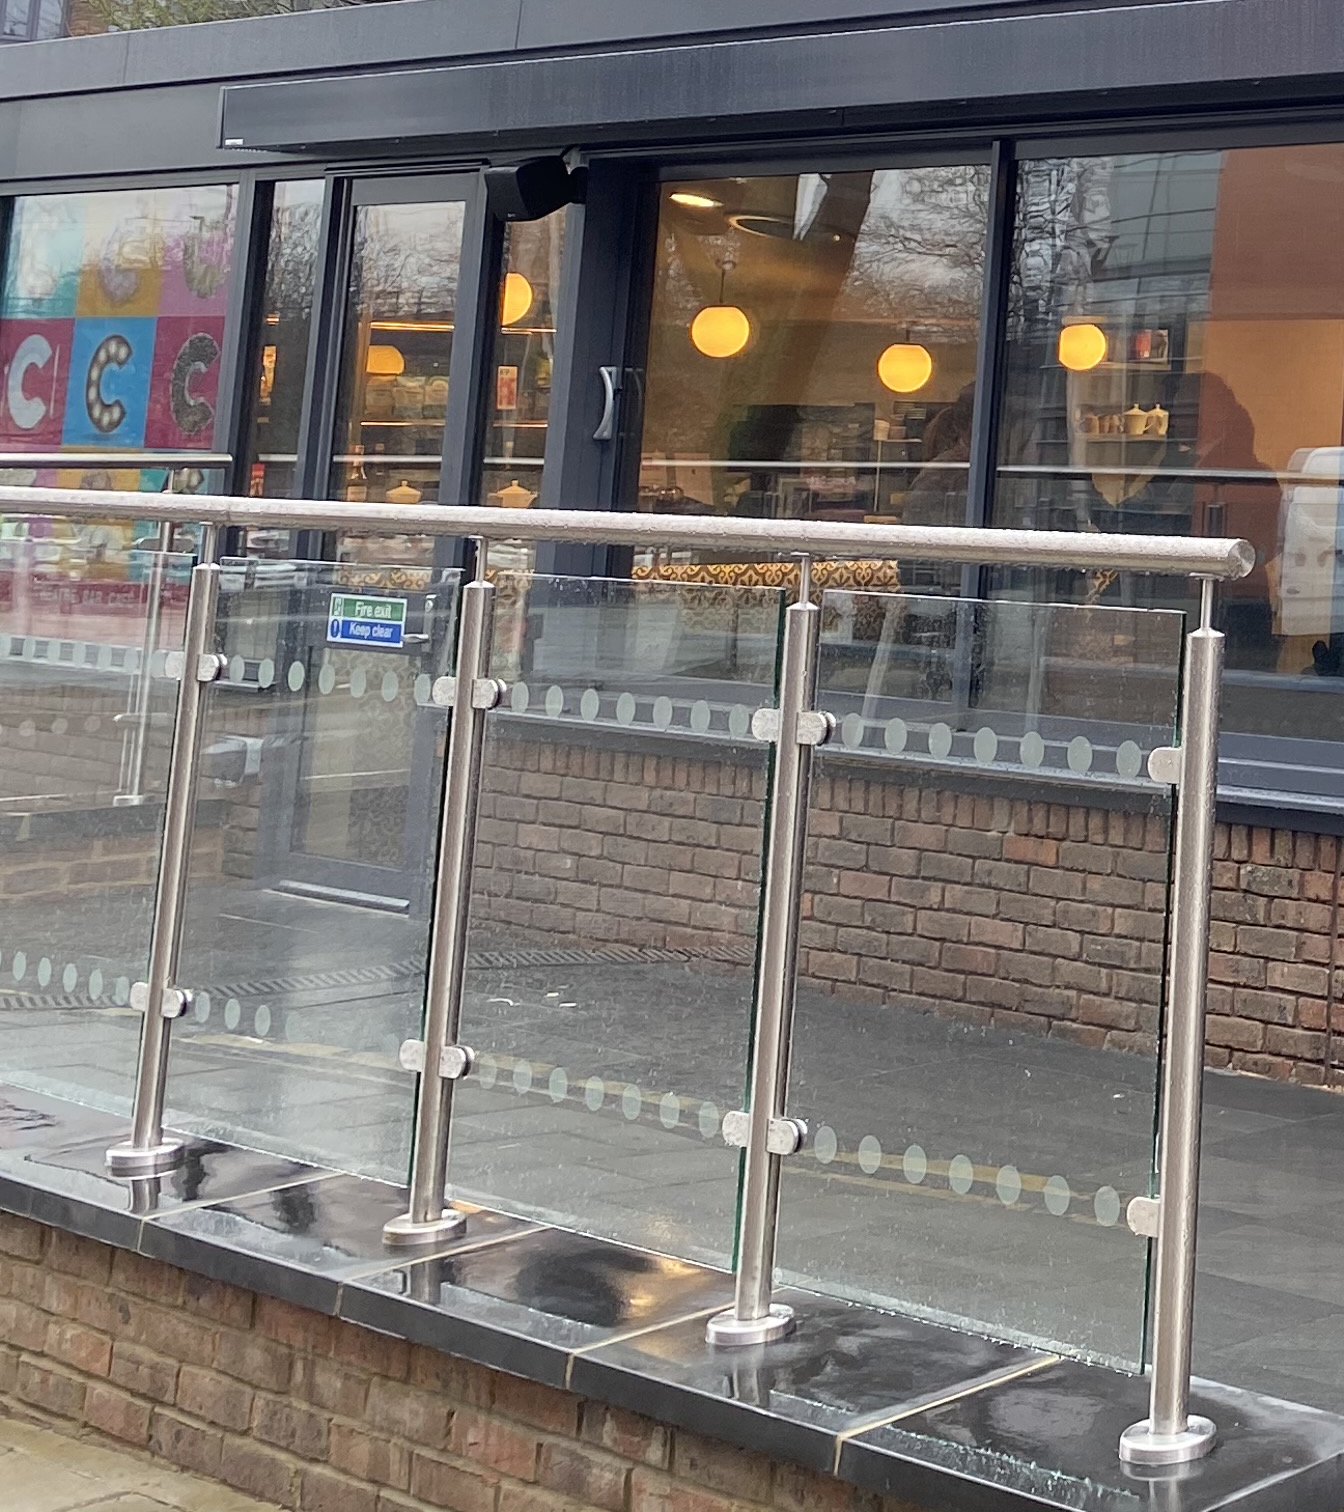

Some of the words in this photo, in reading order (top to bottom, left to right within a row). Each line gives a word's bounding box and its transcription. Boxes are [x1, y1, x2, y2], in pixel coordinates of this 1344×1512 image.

[355, 601, 373, 617] Fire
[373, 604, 392, 619] exit
[349, 622, 371, 639] Keep
[371, 624, 393, 638] clear
